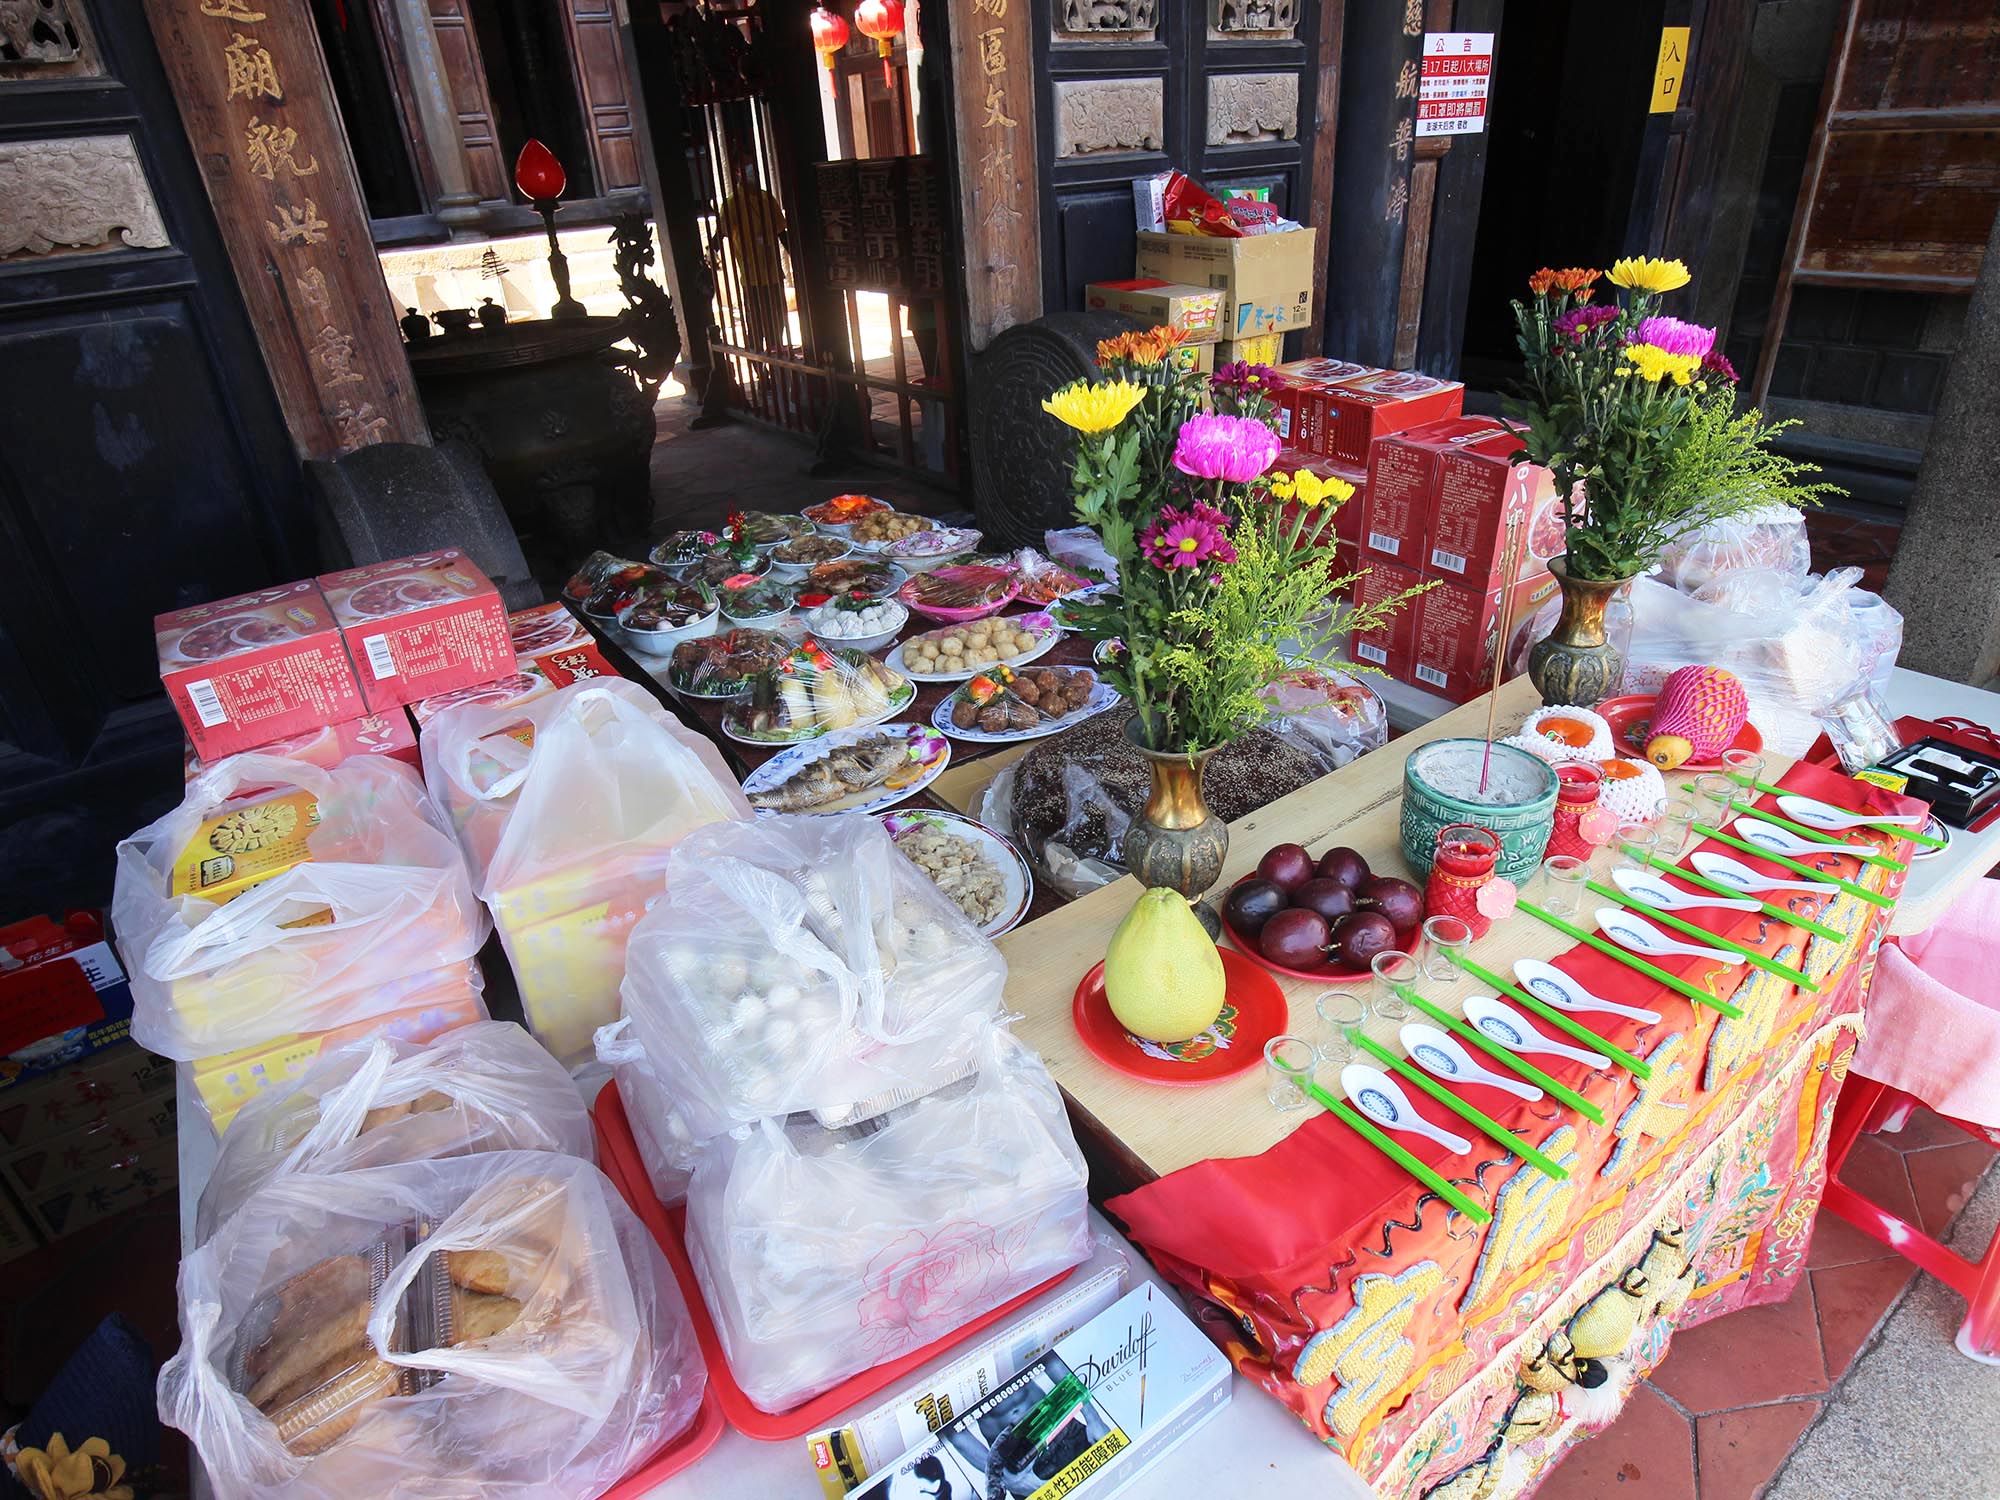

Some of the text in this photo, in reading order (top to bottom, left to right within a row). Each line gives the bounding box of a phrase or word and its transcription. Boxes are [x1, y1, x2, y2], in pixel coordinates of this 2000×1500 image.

[1665, 41, 1681, 95] 入口
[1073, 1312, 1158, 1391] Davidoff
[1105, 1368, 1135, 1393] BLUE
